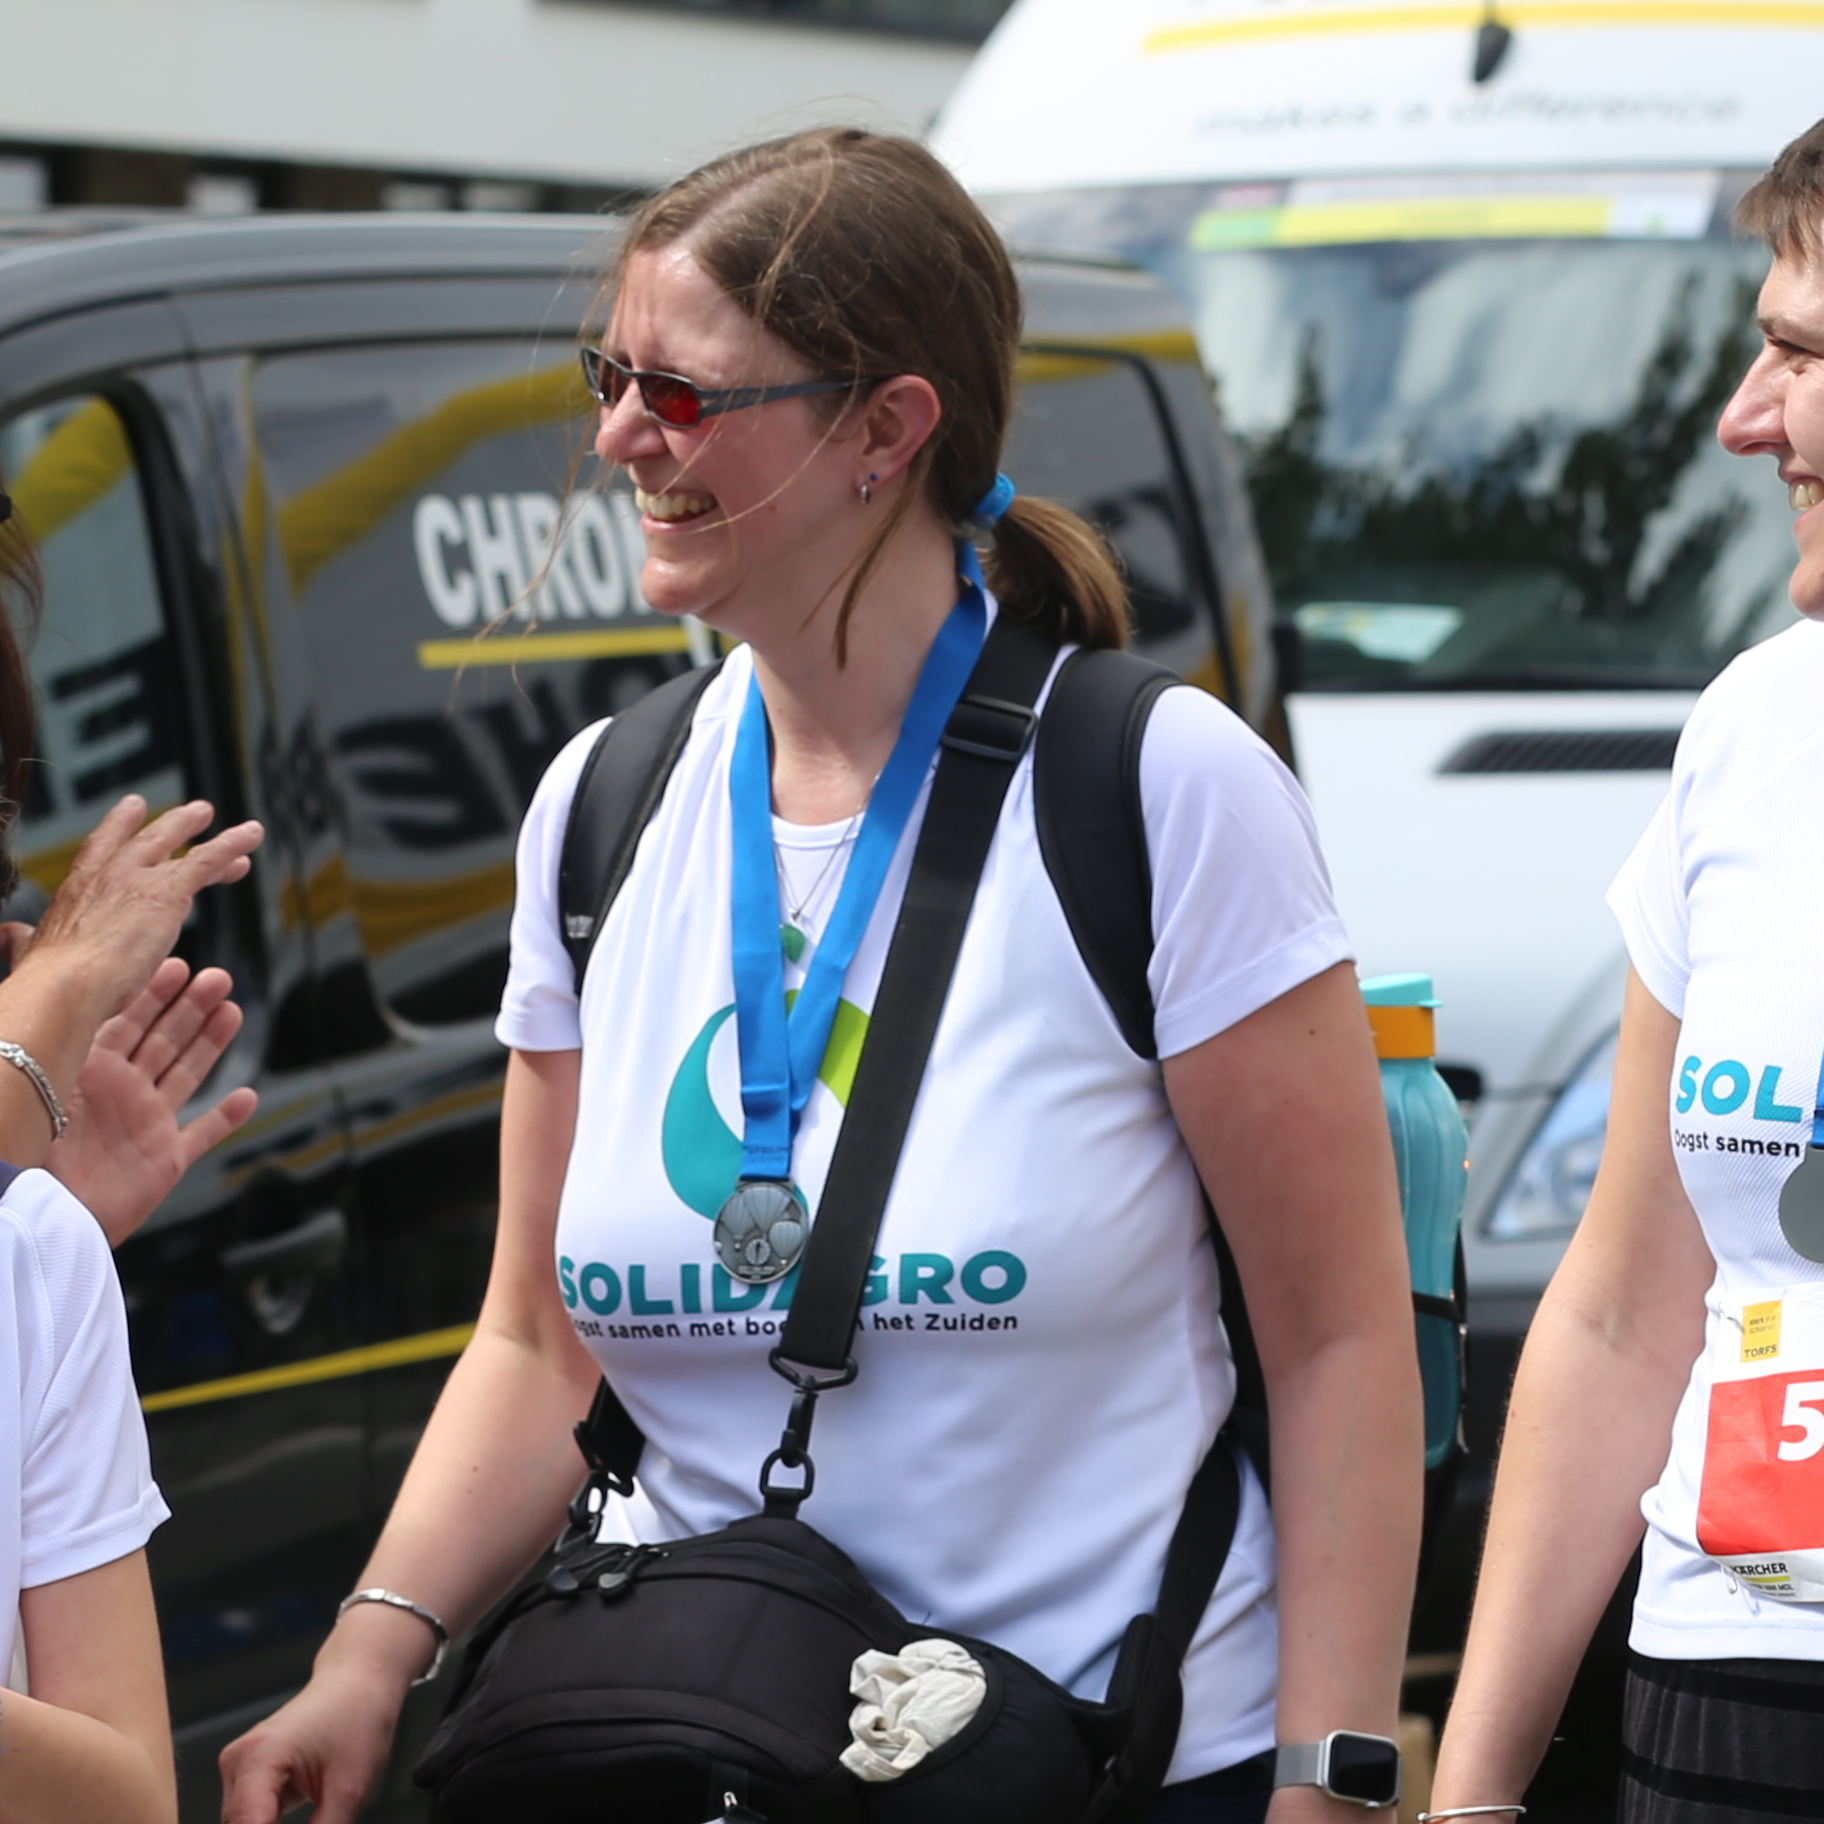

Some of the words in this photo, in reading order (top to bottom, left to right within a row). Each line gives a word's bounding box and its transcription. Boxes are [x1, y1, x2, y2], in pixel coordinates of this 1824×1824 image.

[1716, 1136, 1800, 1158] samen
[608, 1319, 681, 1339] samen
[690, 1318, 737, 1337] met
[874, 1312, 915, 1331] het
[924, 1312, 1018, 1331] Zuiden
[1743, 1344, 1778, 1358] TORFS
